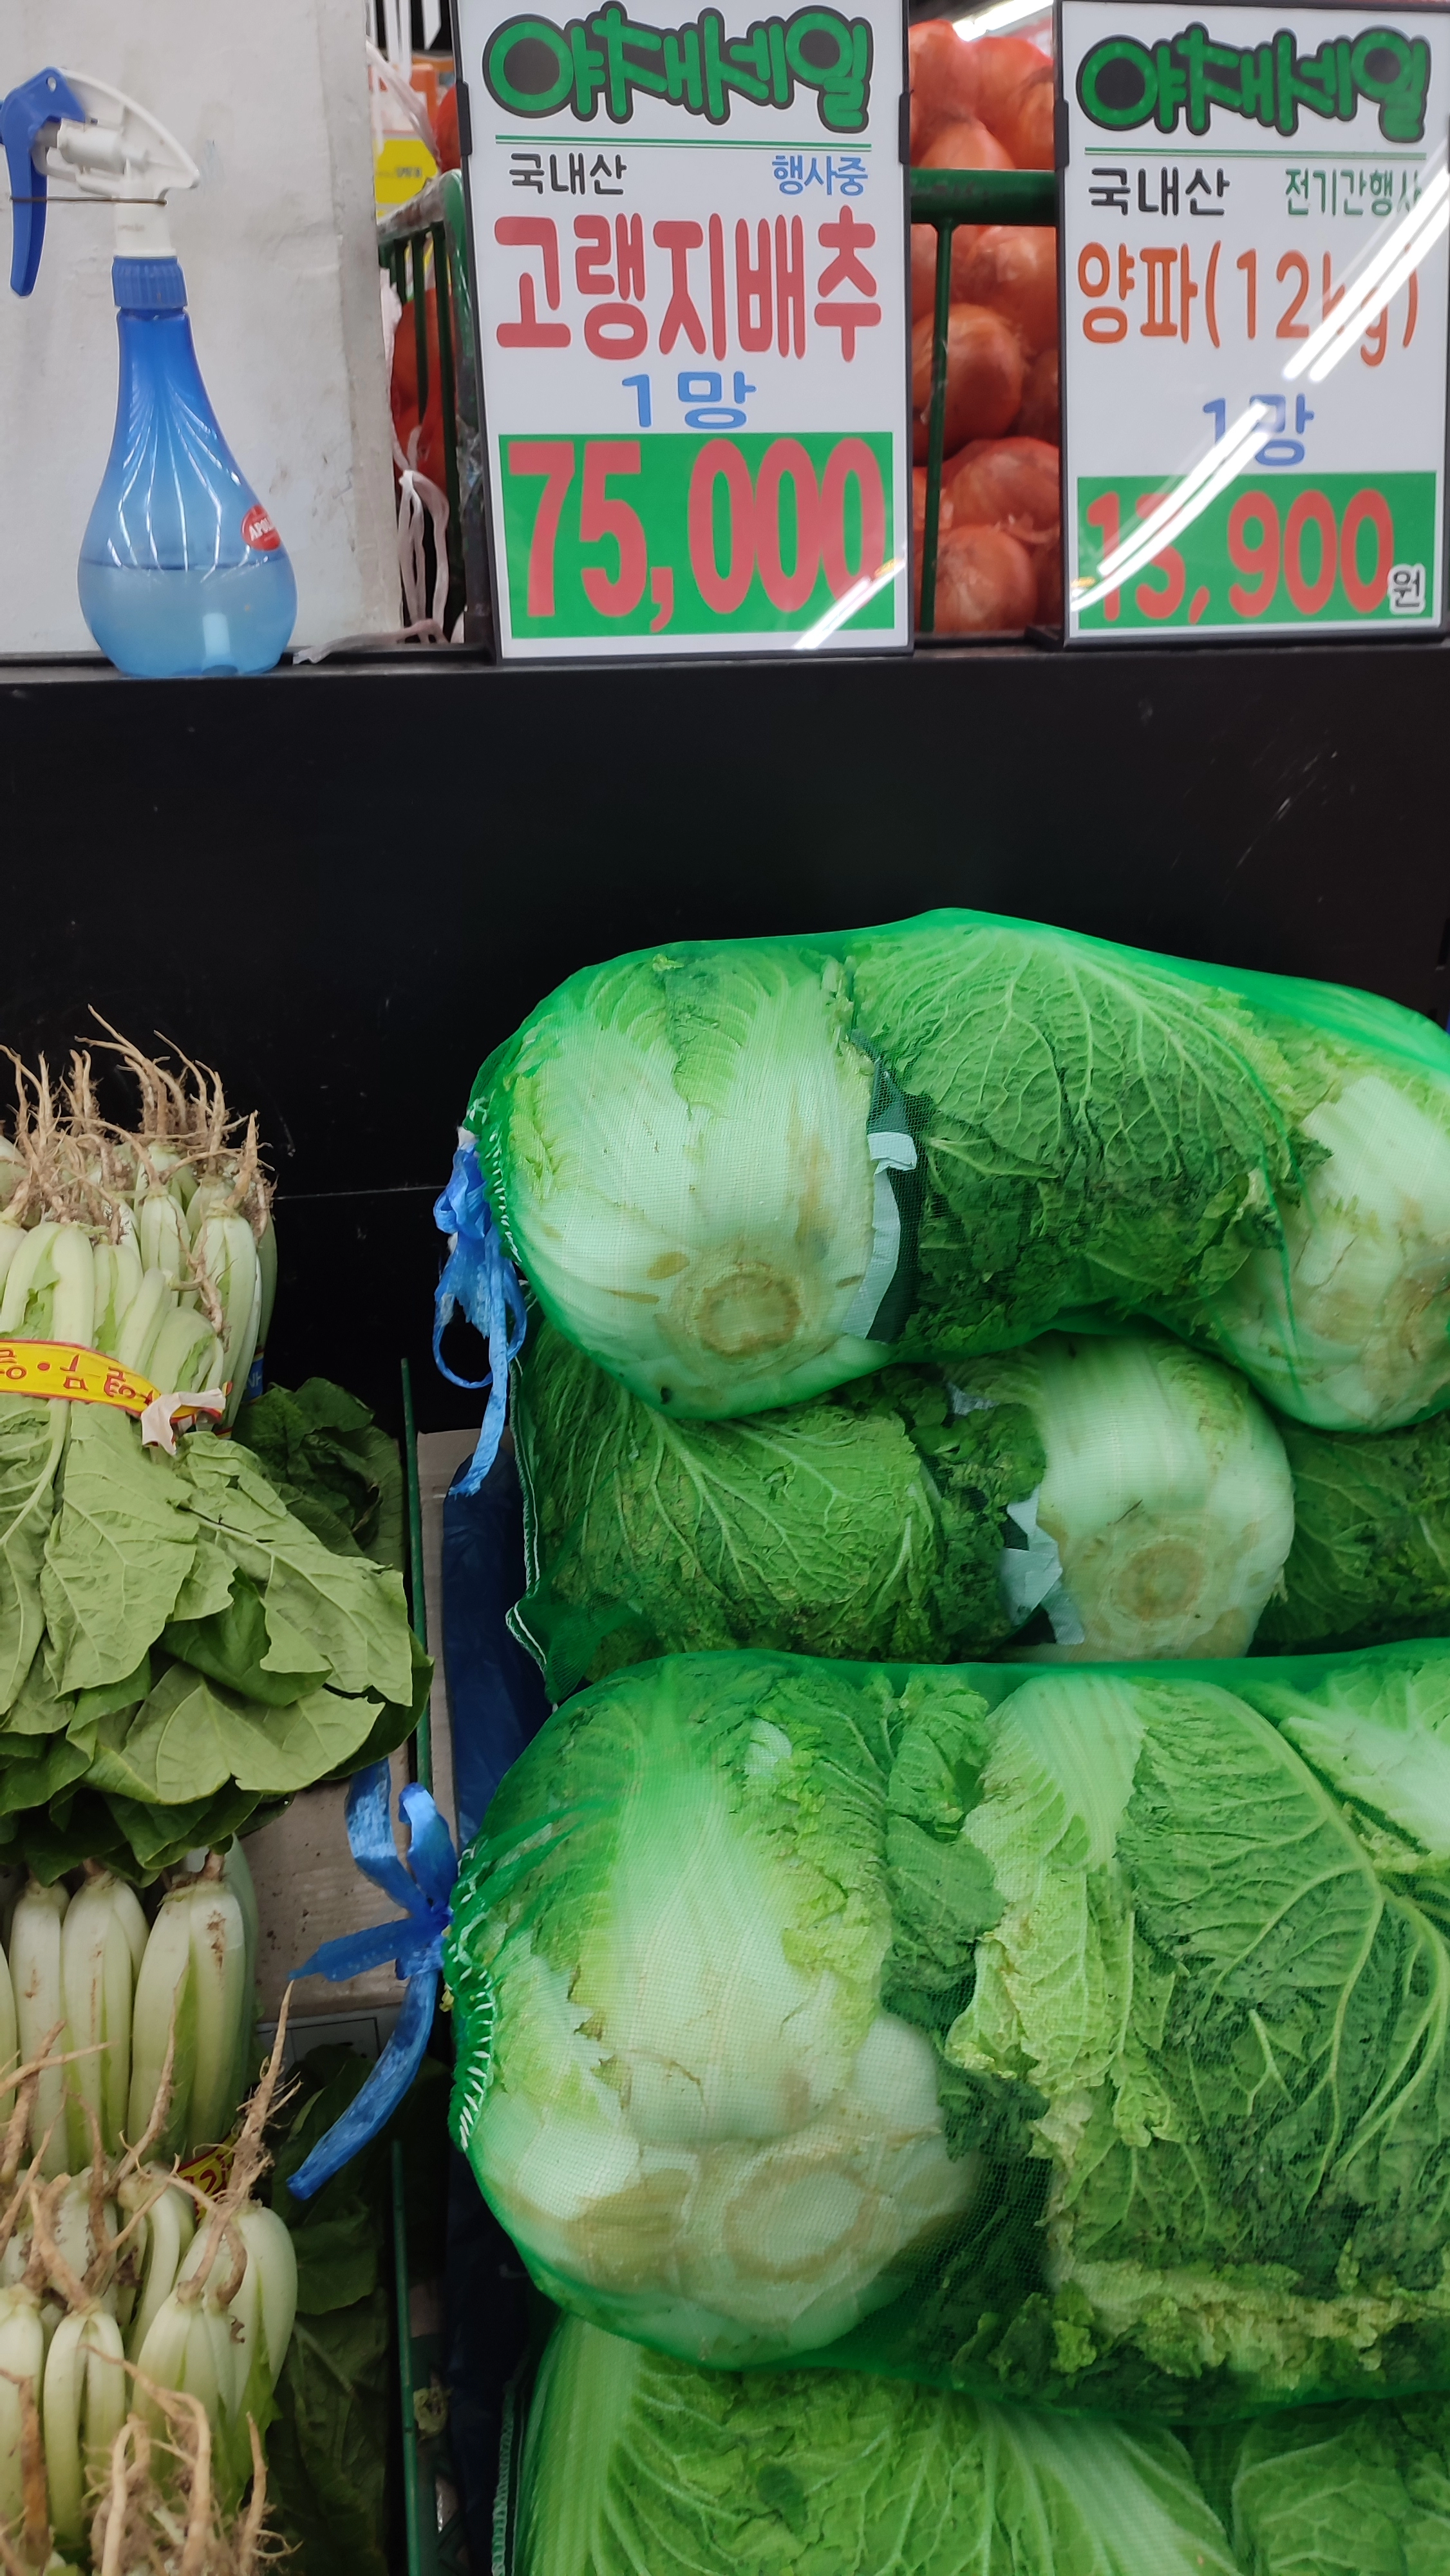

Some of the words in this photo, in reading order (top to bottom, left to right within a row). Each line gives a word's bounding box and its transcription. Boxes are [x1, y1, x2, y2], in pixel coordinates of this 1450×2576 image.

[482, 1, 873, 133] 야채세일
[1077, 22, 1431, 143] 야채세일
[509, 153, 627, 195] 국내산
[772, 155, 868, 196] 행사중
[1088, 166, 1230, 216] 국내산
[494, 205, 881, 363] 고랭지배추
[507, 437, 885, 634] 75,000
